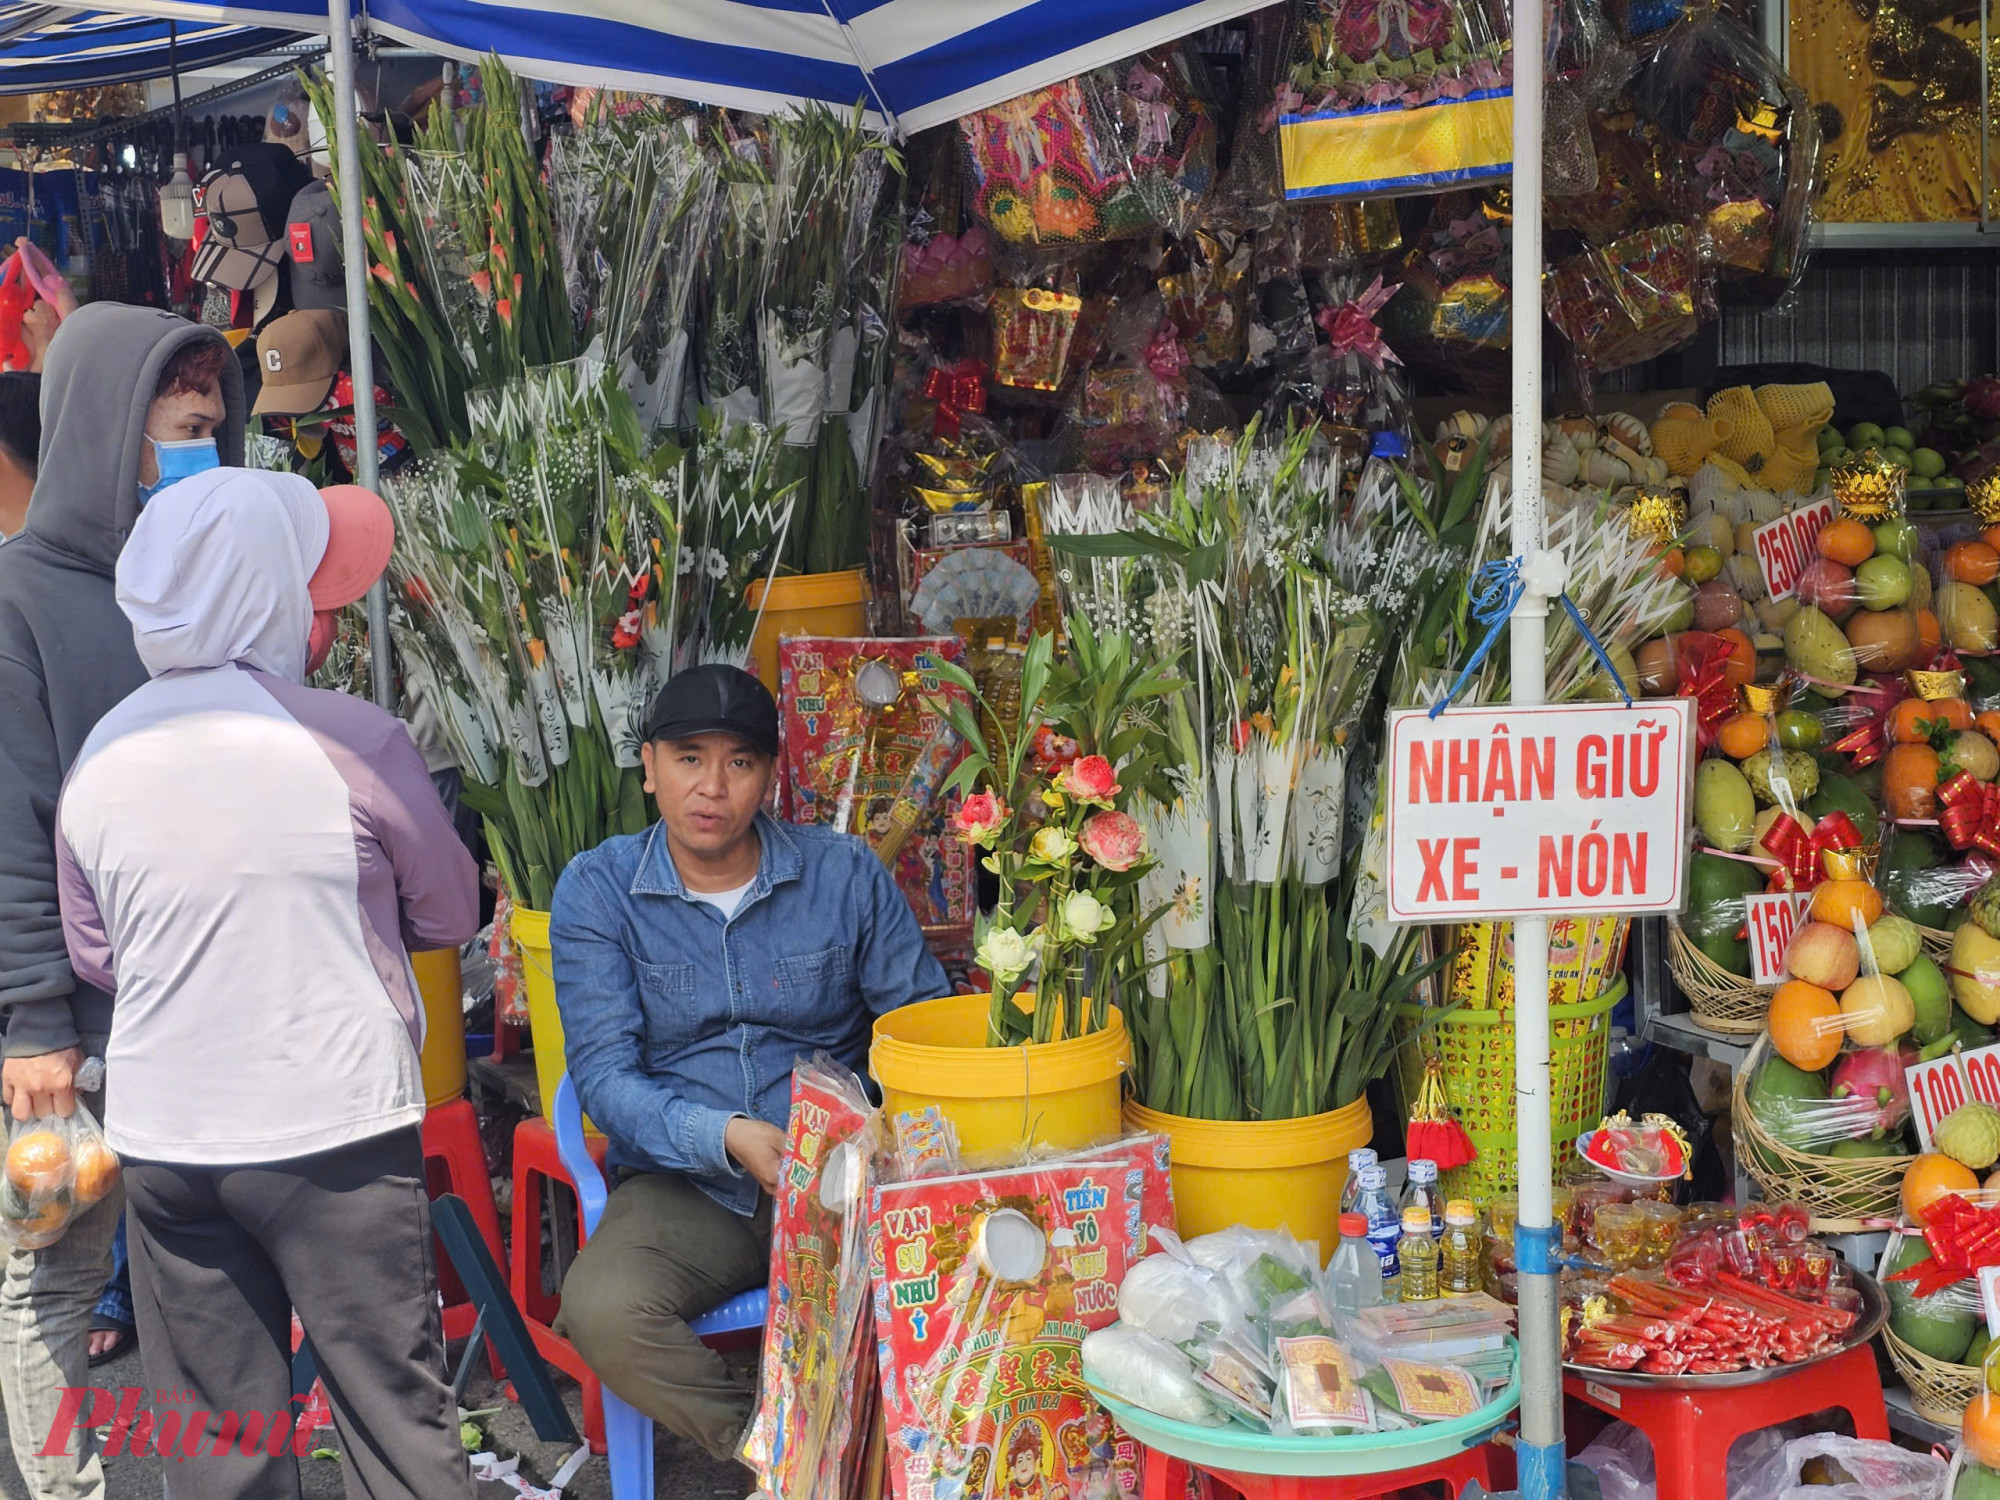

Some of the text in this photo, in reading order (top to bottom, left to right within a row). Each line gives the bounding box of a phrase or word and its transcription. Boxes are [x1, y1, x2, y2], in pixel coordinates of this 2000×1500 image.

[1408, 719, 1668, 817] NHẬN GIỮ
[1415, 837, 1481, 902] XE
[1537, 818, 1649, 899] NÓN
[885, 1207, 931, 1237] VẠN
[1074, 1214, 1099, 1244] VÔ
[897, 1238, 926, 1273] SỰ
[1071, 1246, 1108, 1279] NHƯ
[892, 1274, 938, 1307] NHƯ
[1074, 1280, 1118, 1313] NƯỚC
[909, 1308, 928, 1340] Ý
[1062, 1319, 1089, 1341] MẪU
[990, 1402, 1013, 1425] TẠ
[1041, 1391, 1062, 1411] BÀ
